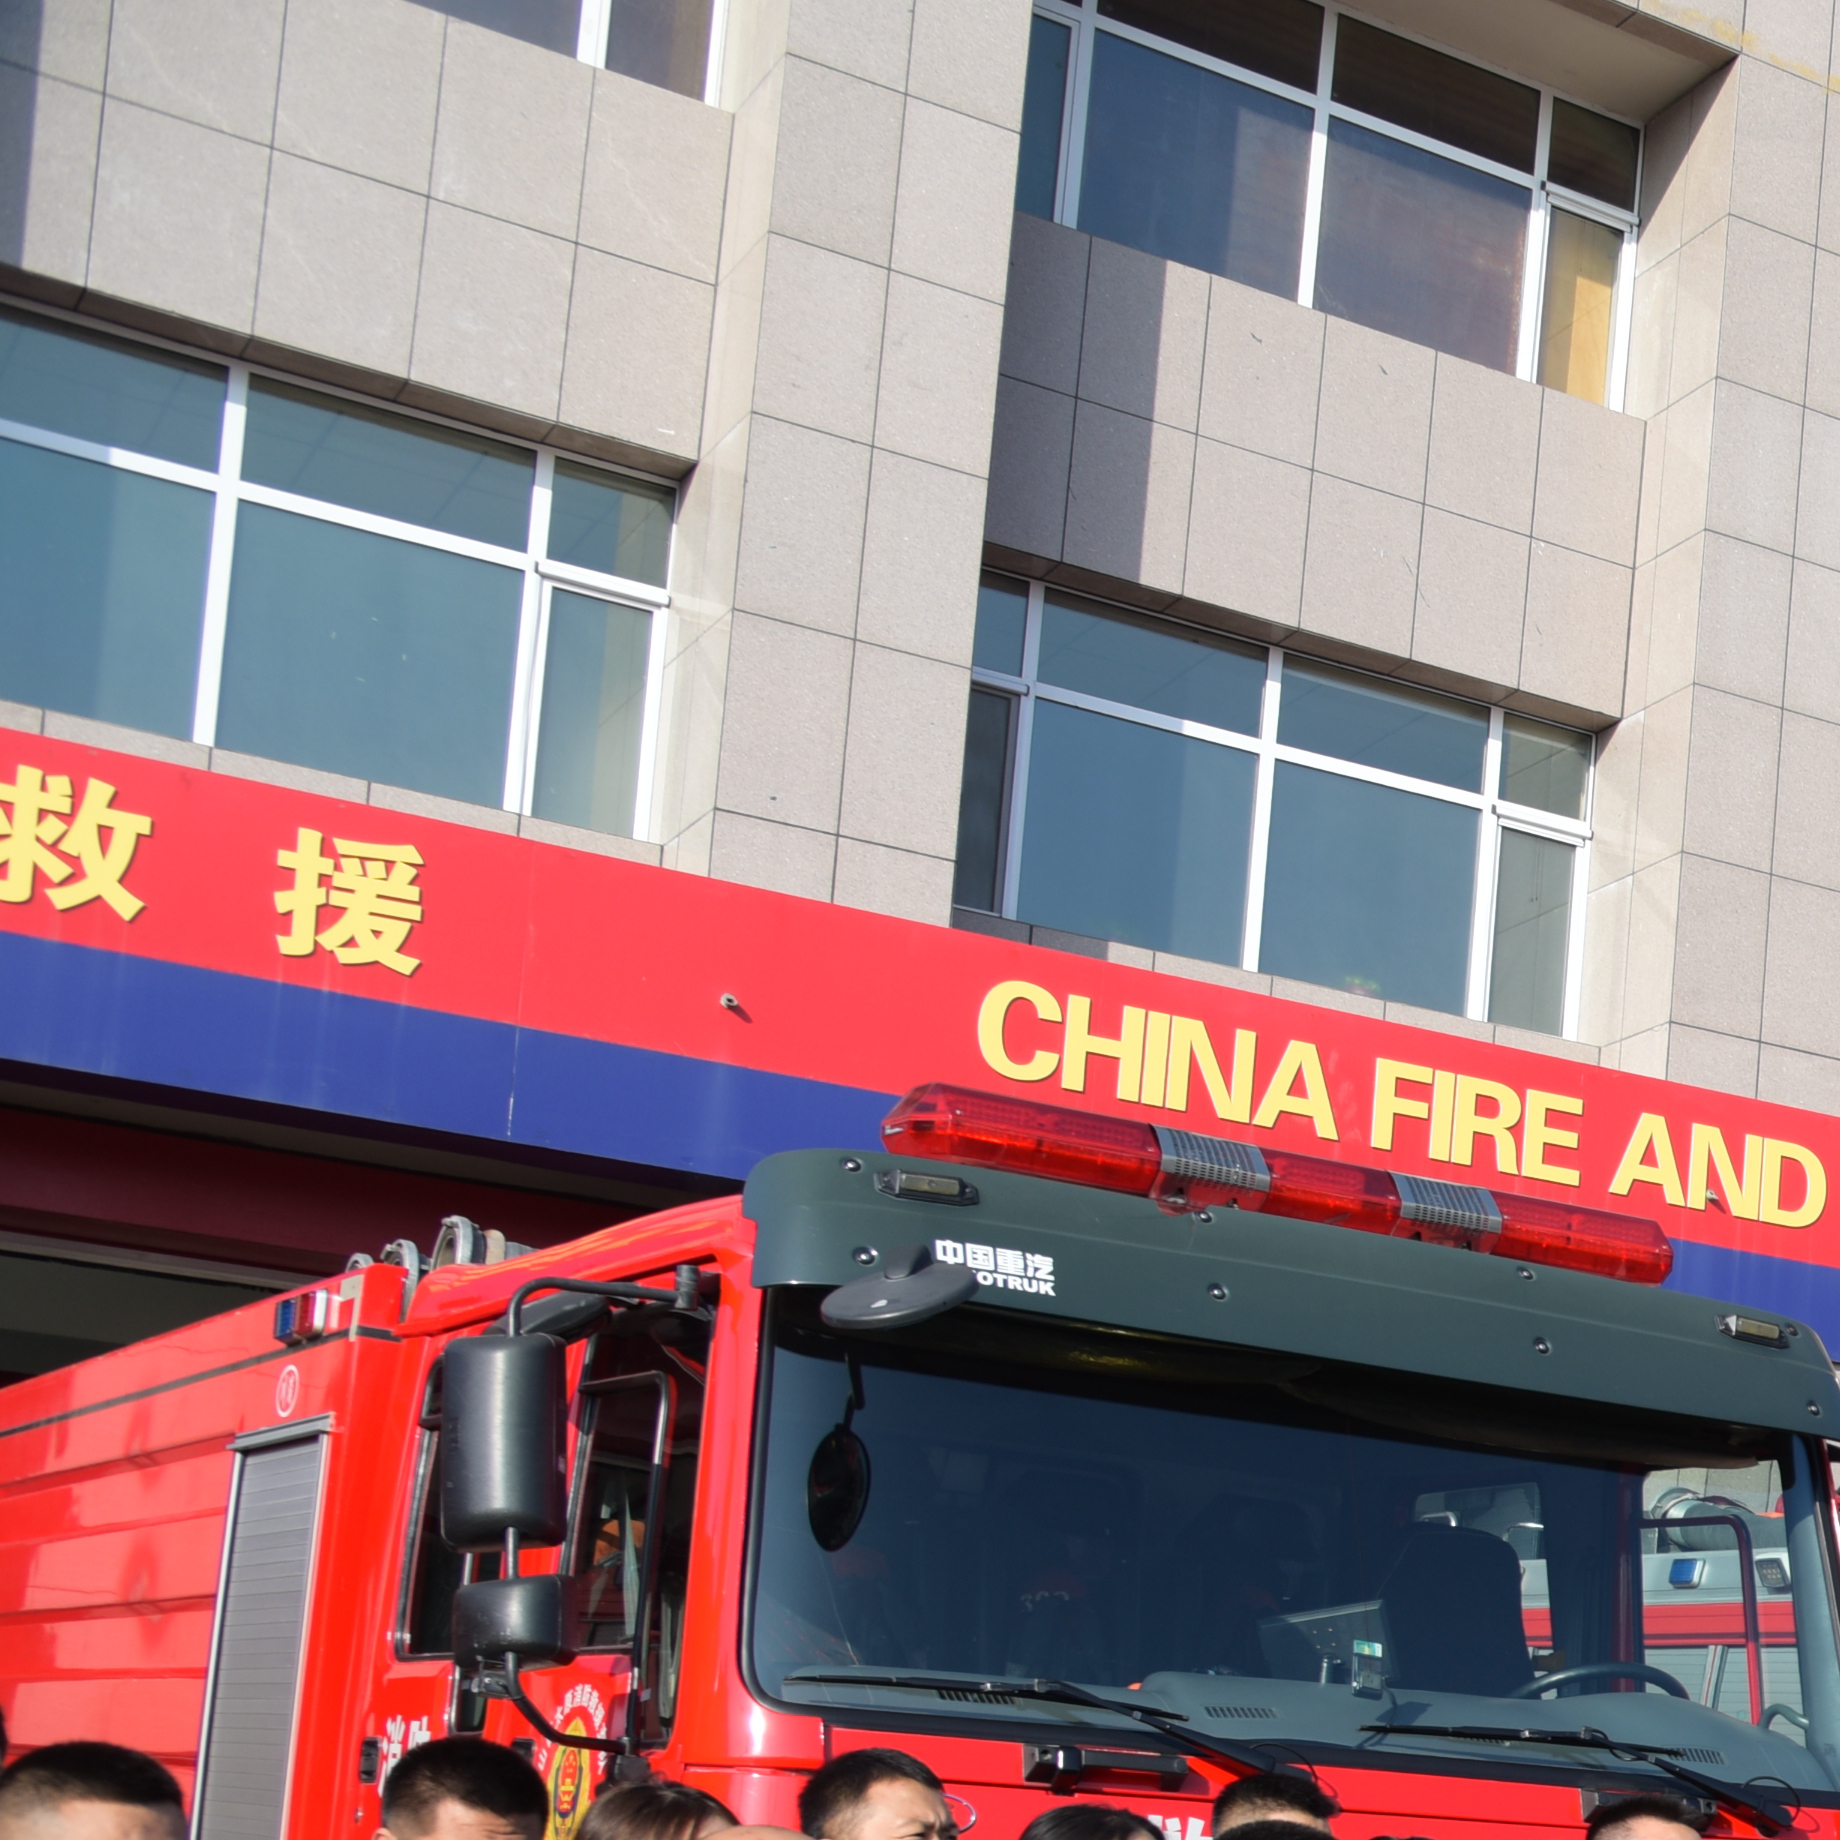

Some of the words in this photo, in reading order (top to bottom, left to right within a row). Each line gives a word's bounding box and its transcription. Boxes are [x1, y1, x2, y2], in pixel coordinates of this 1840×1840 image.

[978, 979, 1339, 1142] CHINA
[1372, 1057, 1584, 1187] FIRE
[1610, 1112, 1827, 1229] AND
[935, 1239, 1055, 1280] 中国重汽
[974, 1270, 1056, 1297] OTRUK
